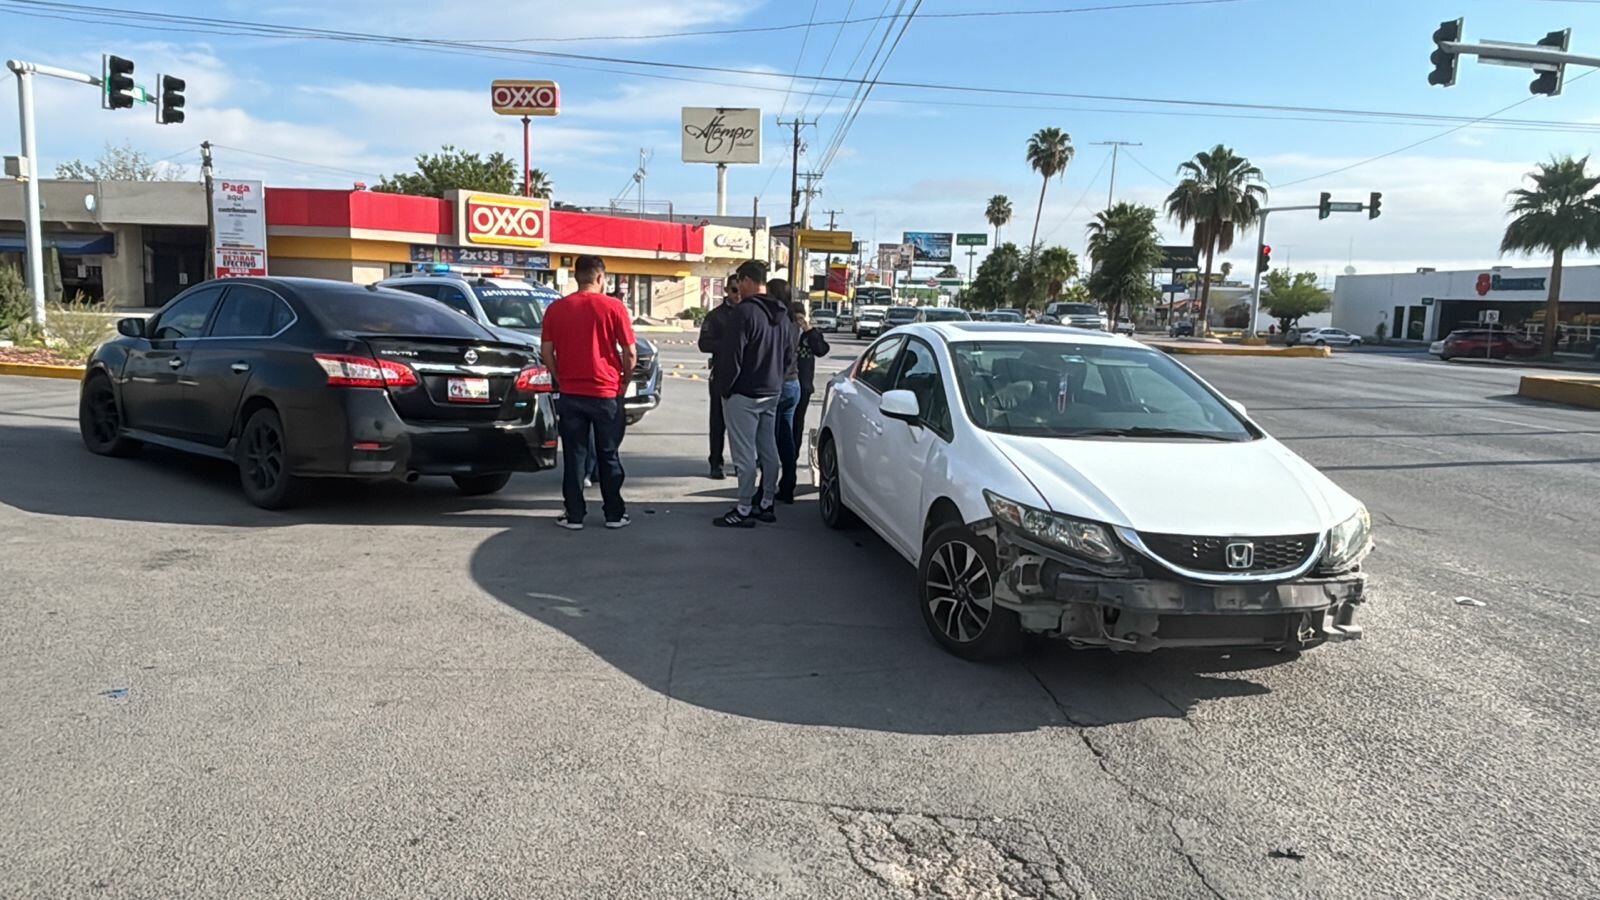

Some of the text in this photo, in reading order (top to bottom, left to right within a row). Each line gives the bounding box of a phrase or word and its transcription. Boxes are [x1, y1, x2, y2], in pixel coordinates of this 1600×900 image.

[494, 86, 554, 108] OXXO
[222, 182, 250, 194] Paga
[472, 207, 541, 236] OXXO
